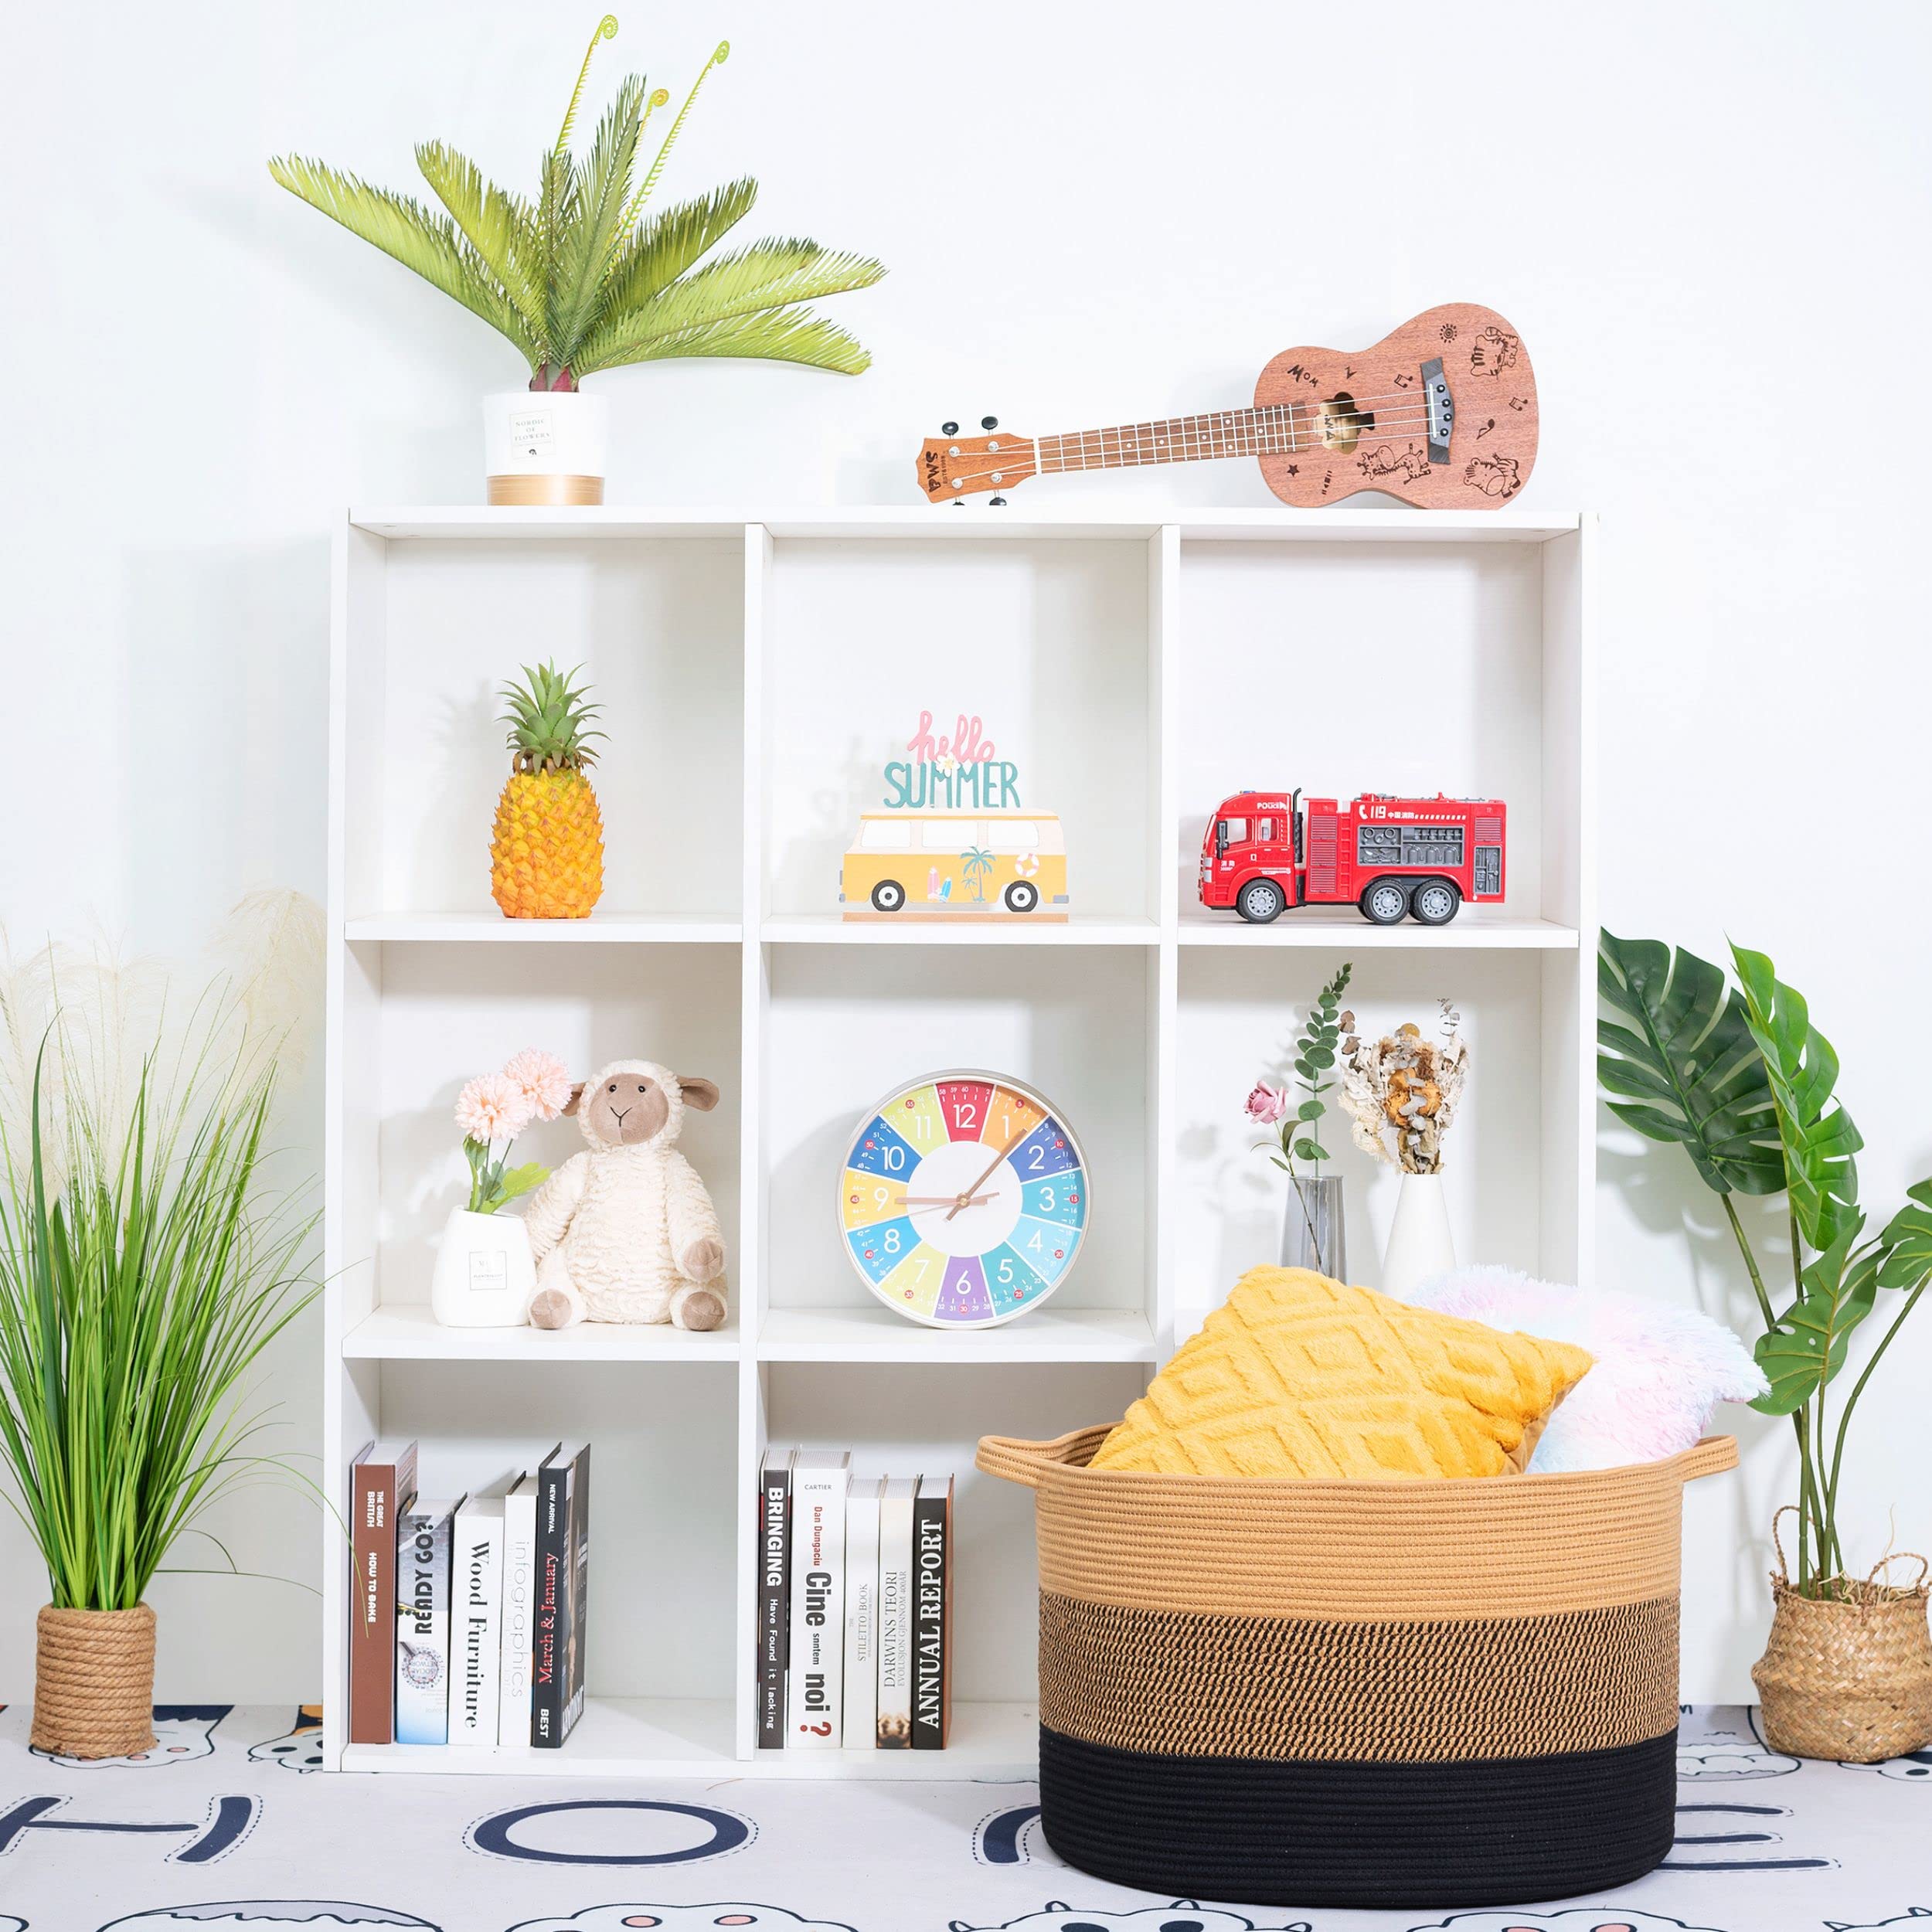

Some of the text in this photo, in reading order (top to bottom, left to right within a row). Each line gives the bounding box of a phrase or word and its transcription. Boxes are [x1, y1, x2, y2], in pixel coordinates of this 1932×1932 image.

[906, 711, 995, 765] hello
[883, 761, 1020, 808] SUMMER
[1370, 805, 1386, 819] 119
[915, 1116, 930, 1139] 11
[953, 1104, 977, 1128] 12
[1002, 1115, 1009, 1138] 1
[881, 1145, 905, 1171] 10
[1028, 1145, 1045, 1170] 2
[874, 1187, 889, 1212] 9
[1039, 1187, 1056, 1212] 3
[883, 1228, 900, 1253] 8
[1027, 1229, 1043, 1252] 4
[915, 1260, 930, 1283] 7
[956, 1270, 971, 1294] 6
[997, 1259, 1013, 1283] 5
[767, 1487, 784, 1587] BRINGING
[812, 1506, 823, 1566] Dan Dungaciu
[369, 1553, 377, 1577] HOW
[415, 1522, 434, 1634] READY GO?
[369, 1579, 376, 1592] TO
[806, 1572, 832, 1626] Cine
[510, 1542, 531, 1697] infographics
[539, 1553, 559, 1683] March & January
[857, 1583, 868, 1662] STILETTO BOOK
[884, 1572, 896, 1687] DARWINS TEORI
[897, 1596, 907, 1637] GJENNOM
[918, 1519, 943, 1730] ANNUAL REPORT
[464, 1541, 490, 1728] Wood Furniture
[766, 1599, 778, 1730] Have Found it lacking
[897, 1639, 906, 1686] EVOLUSJON
[805, 1674, 830, 1711] noi
[540, 1709, 549, 1738] BEST
[800, 1722, 832, 1736] ?
